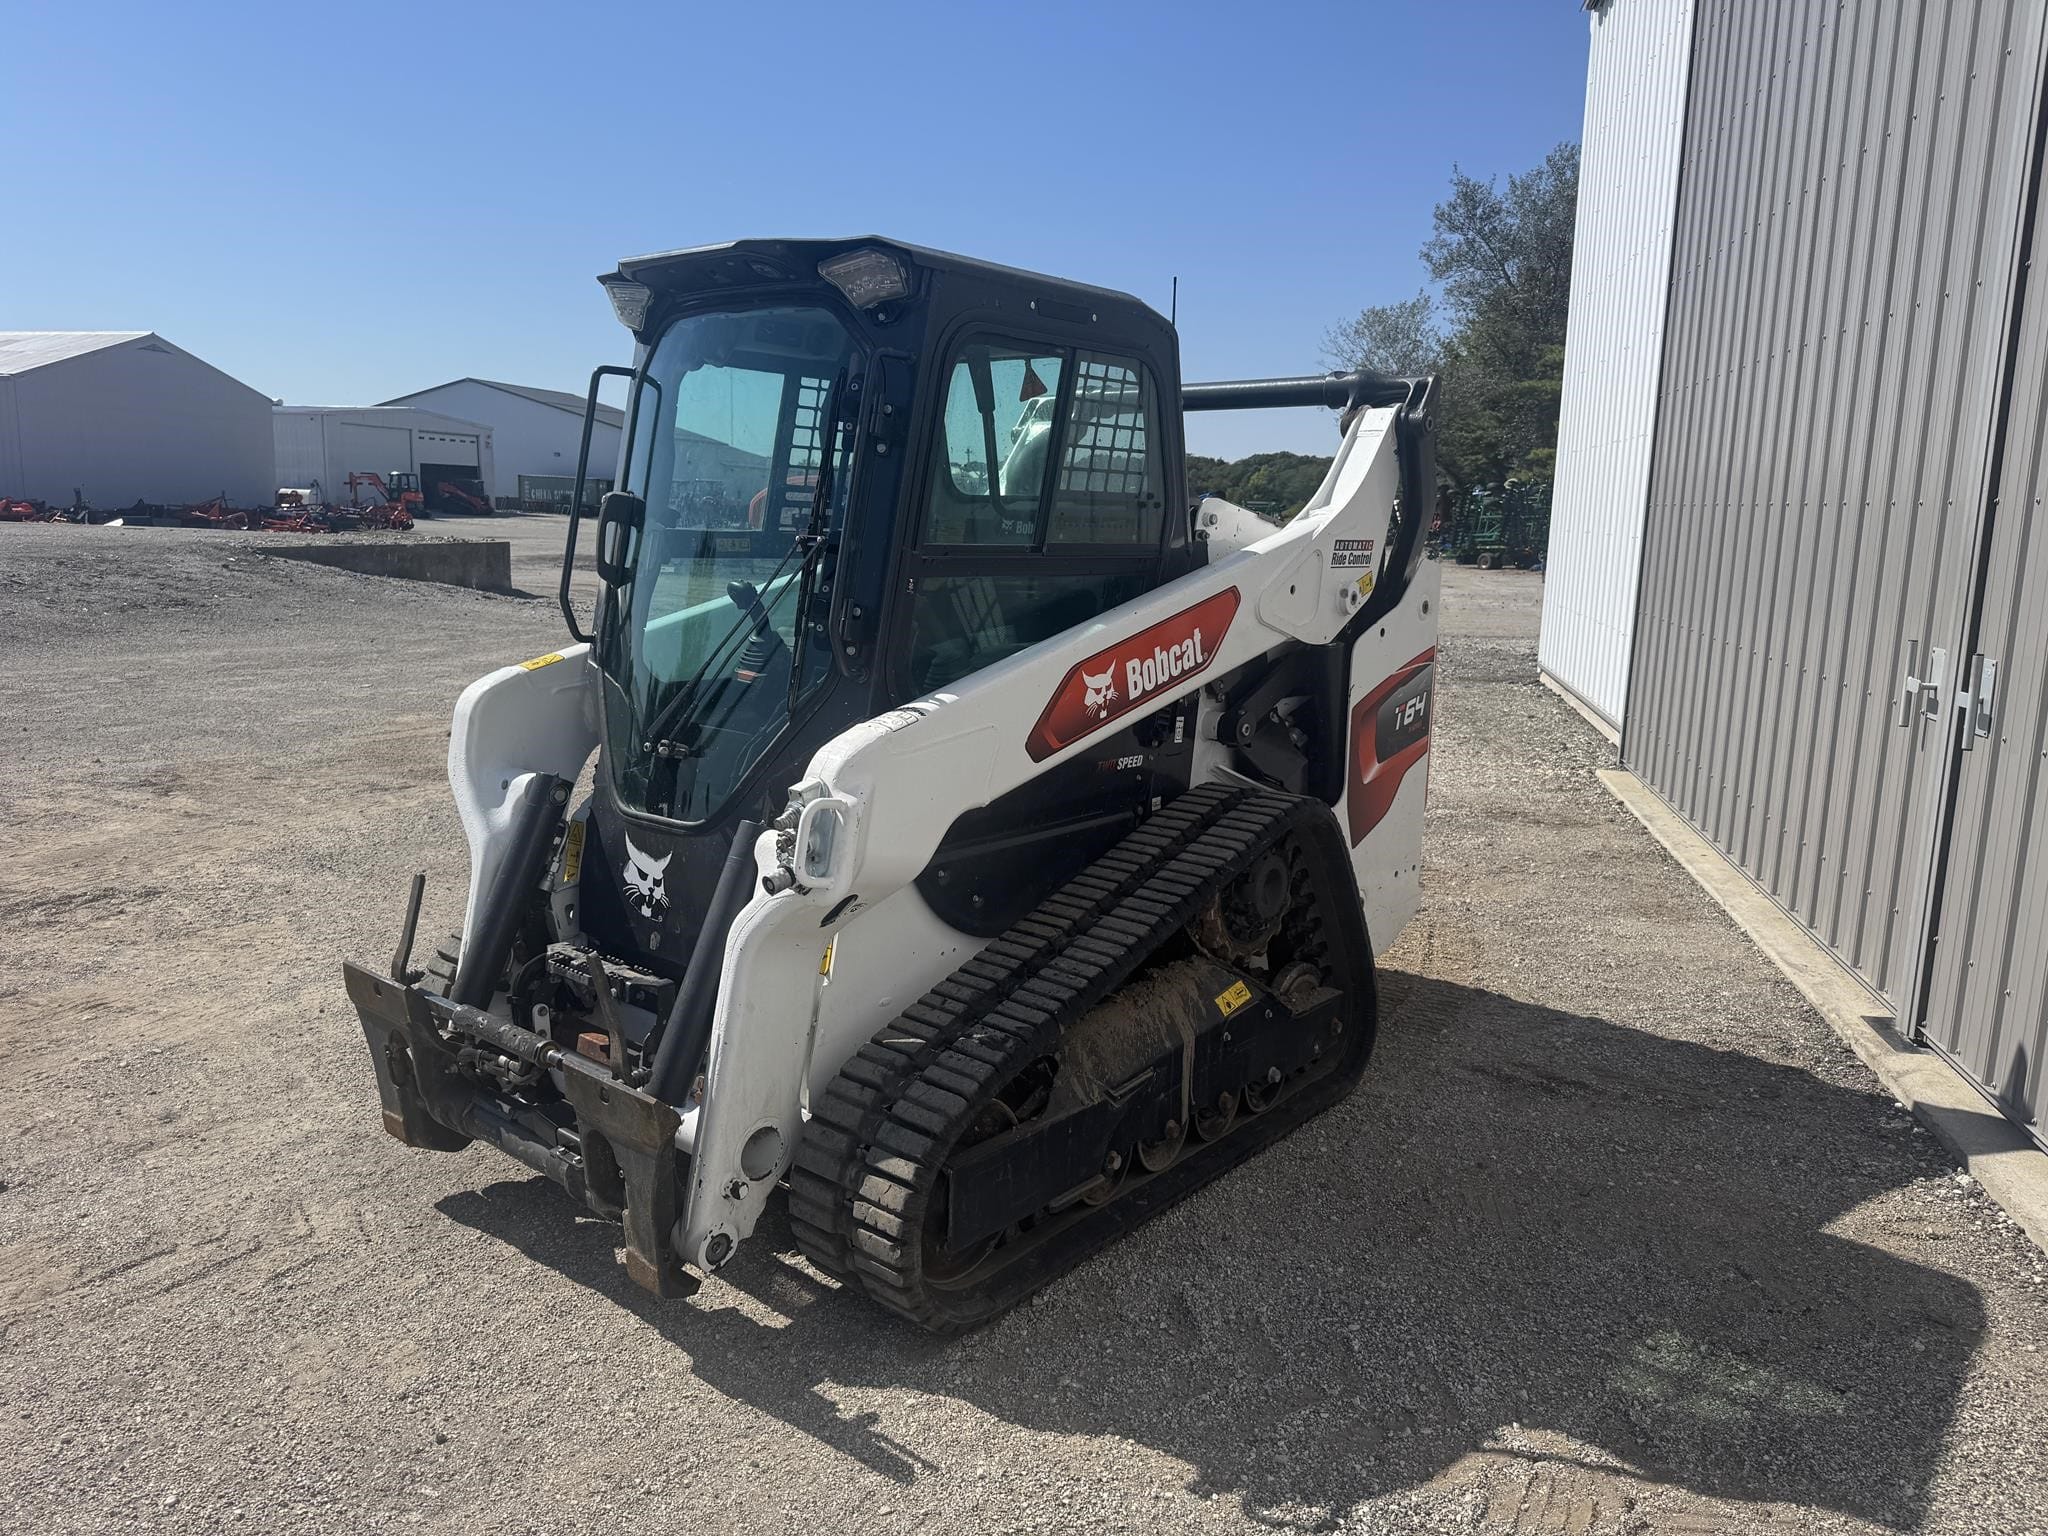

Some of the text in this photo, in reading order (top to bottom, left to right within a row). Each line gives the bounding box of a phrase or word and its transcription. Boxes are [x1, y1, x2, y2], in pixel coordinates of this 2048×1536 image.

[1016, 520, 1035, 535] Bob
[1335, 541, 1373, 551] AUTOMATIC
[1331, 552, 1373, 566] Ride Control
[1126, 627, 1204, 701] Bobcat
[1395, 691, 1427, 731] T64
